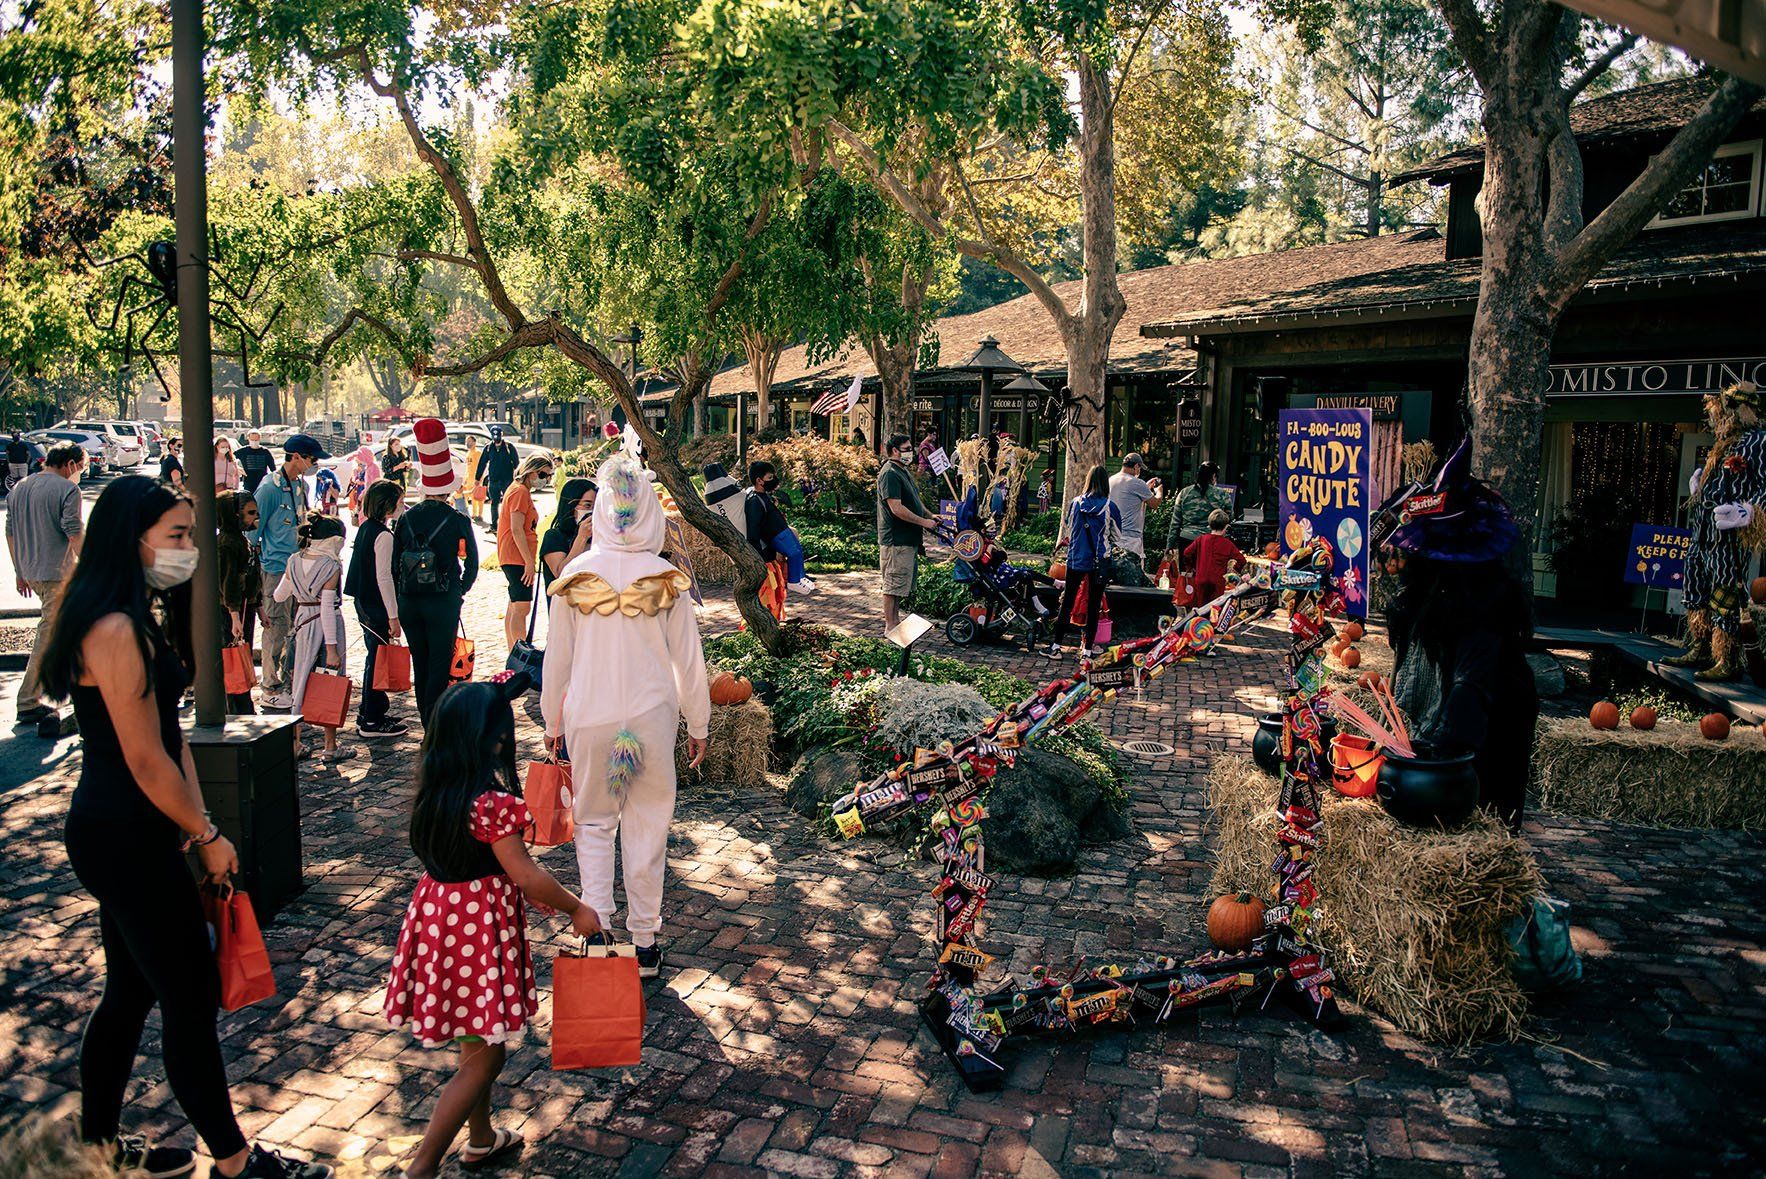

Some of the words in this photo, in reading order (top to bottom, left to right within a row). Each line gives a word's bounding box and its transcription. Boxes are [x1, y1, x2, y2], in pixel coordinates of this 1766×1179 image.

[1316, 396, 1359, 410] DANVILLE
[1364, 394, 1398, 414] LIVERY
[1181, 420, 1201, 428] MISTO
[1182, 429, 1199, 437] LINO
[1285, 440, 1363, 475] CANDY
[1286, 474, 1360, 516] CHUTE
[1653, 533, 1693, 548] PLEAS
[1636, 545, 1667, 559] KEEP
[1668, 549, 1677, 559] 6
[1280, 574, 1318, 586] Skittles
[1090, 670, 1123, 685] HERSHEY'S
[911, 768, 946, 785] HERSHEY'S
[945, 778, 977, 801] HERSHEY'S
